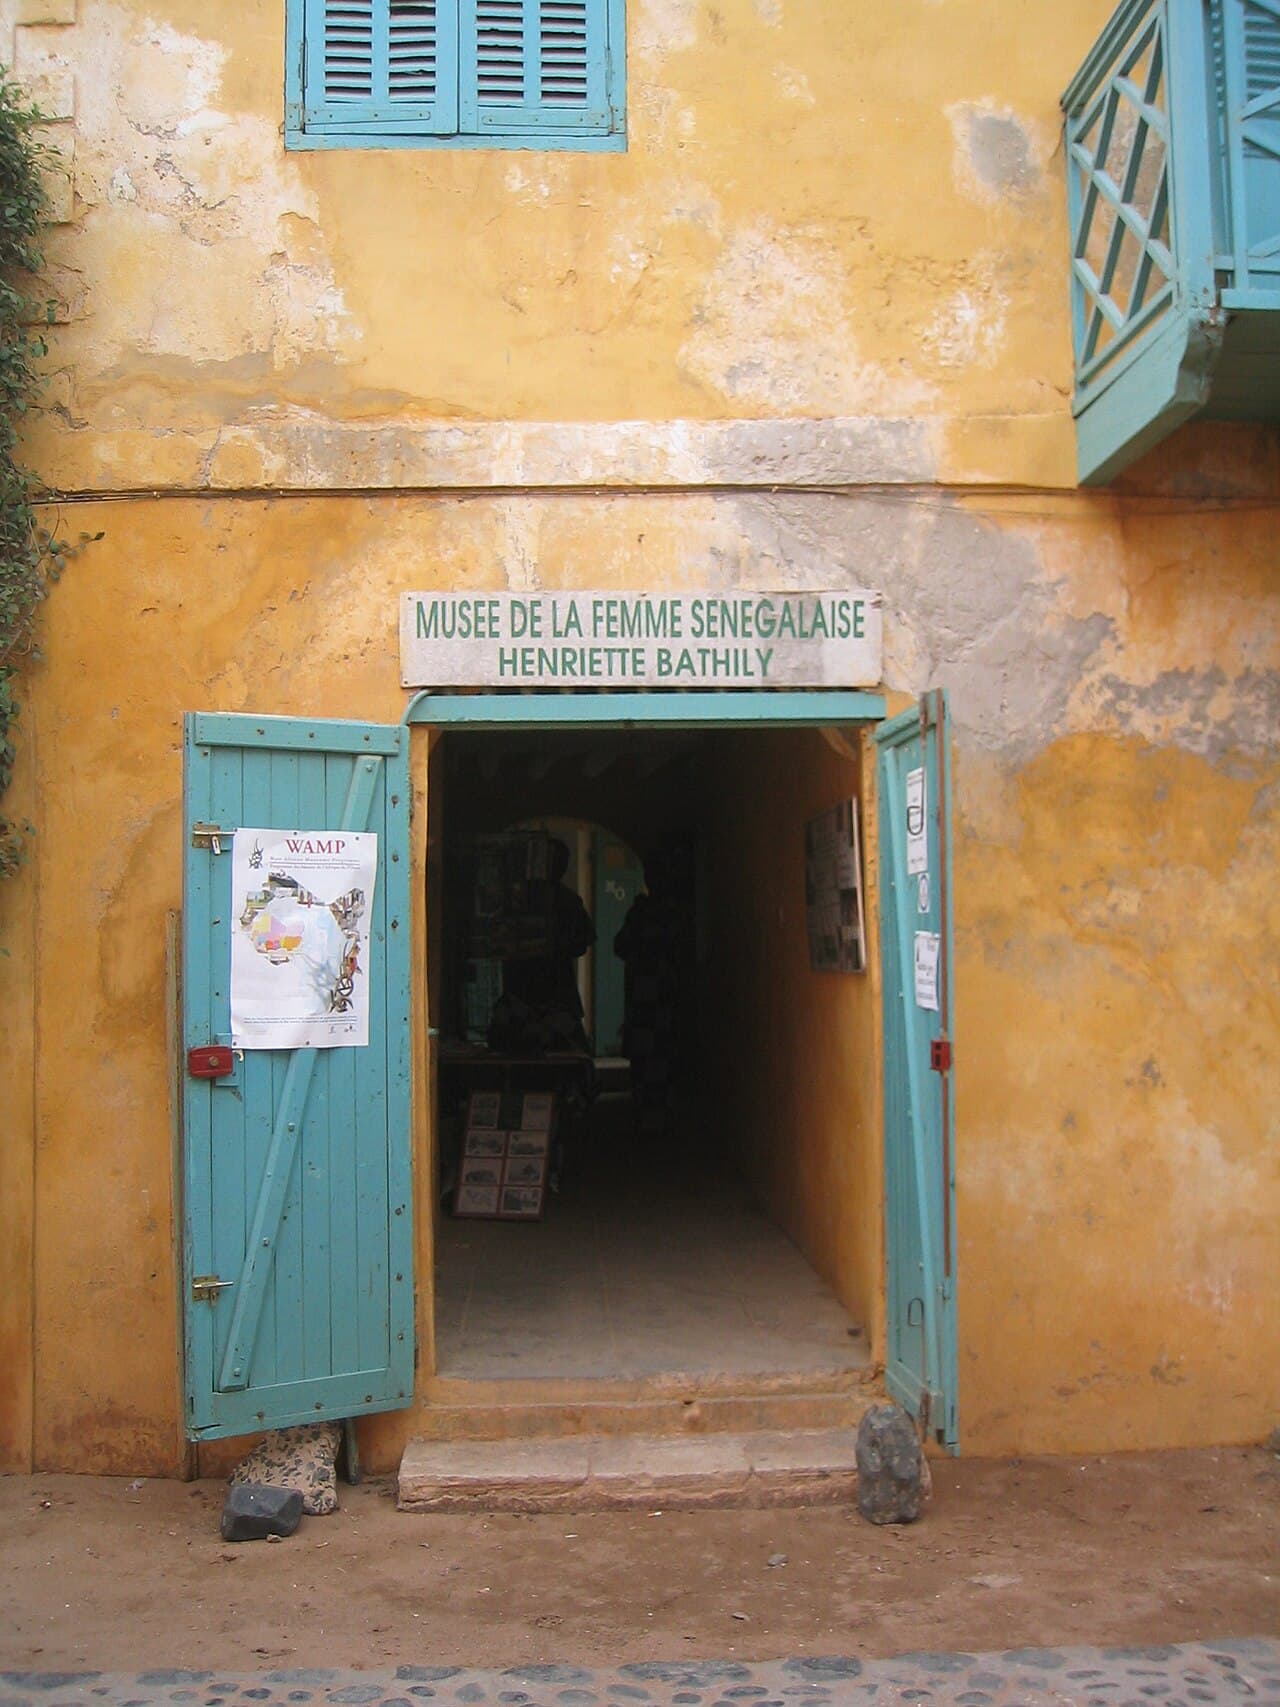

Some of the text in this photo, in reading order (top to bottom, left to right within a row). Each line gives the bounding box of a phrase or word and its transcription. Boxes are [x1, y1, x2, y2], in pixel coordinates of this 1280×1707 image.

[416, 598, 865, 639] MUSEE DE LA FEMME SENEGALAISE
[498, 647, 774, 677] HENRIETTE BATHILY
[285, 839, 346, 854] WAMP
